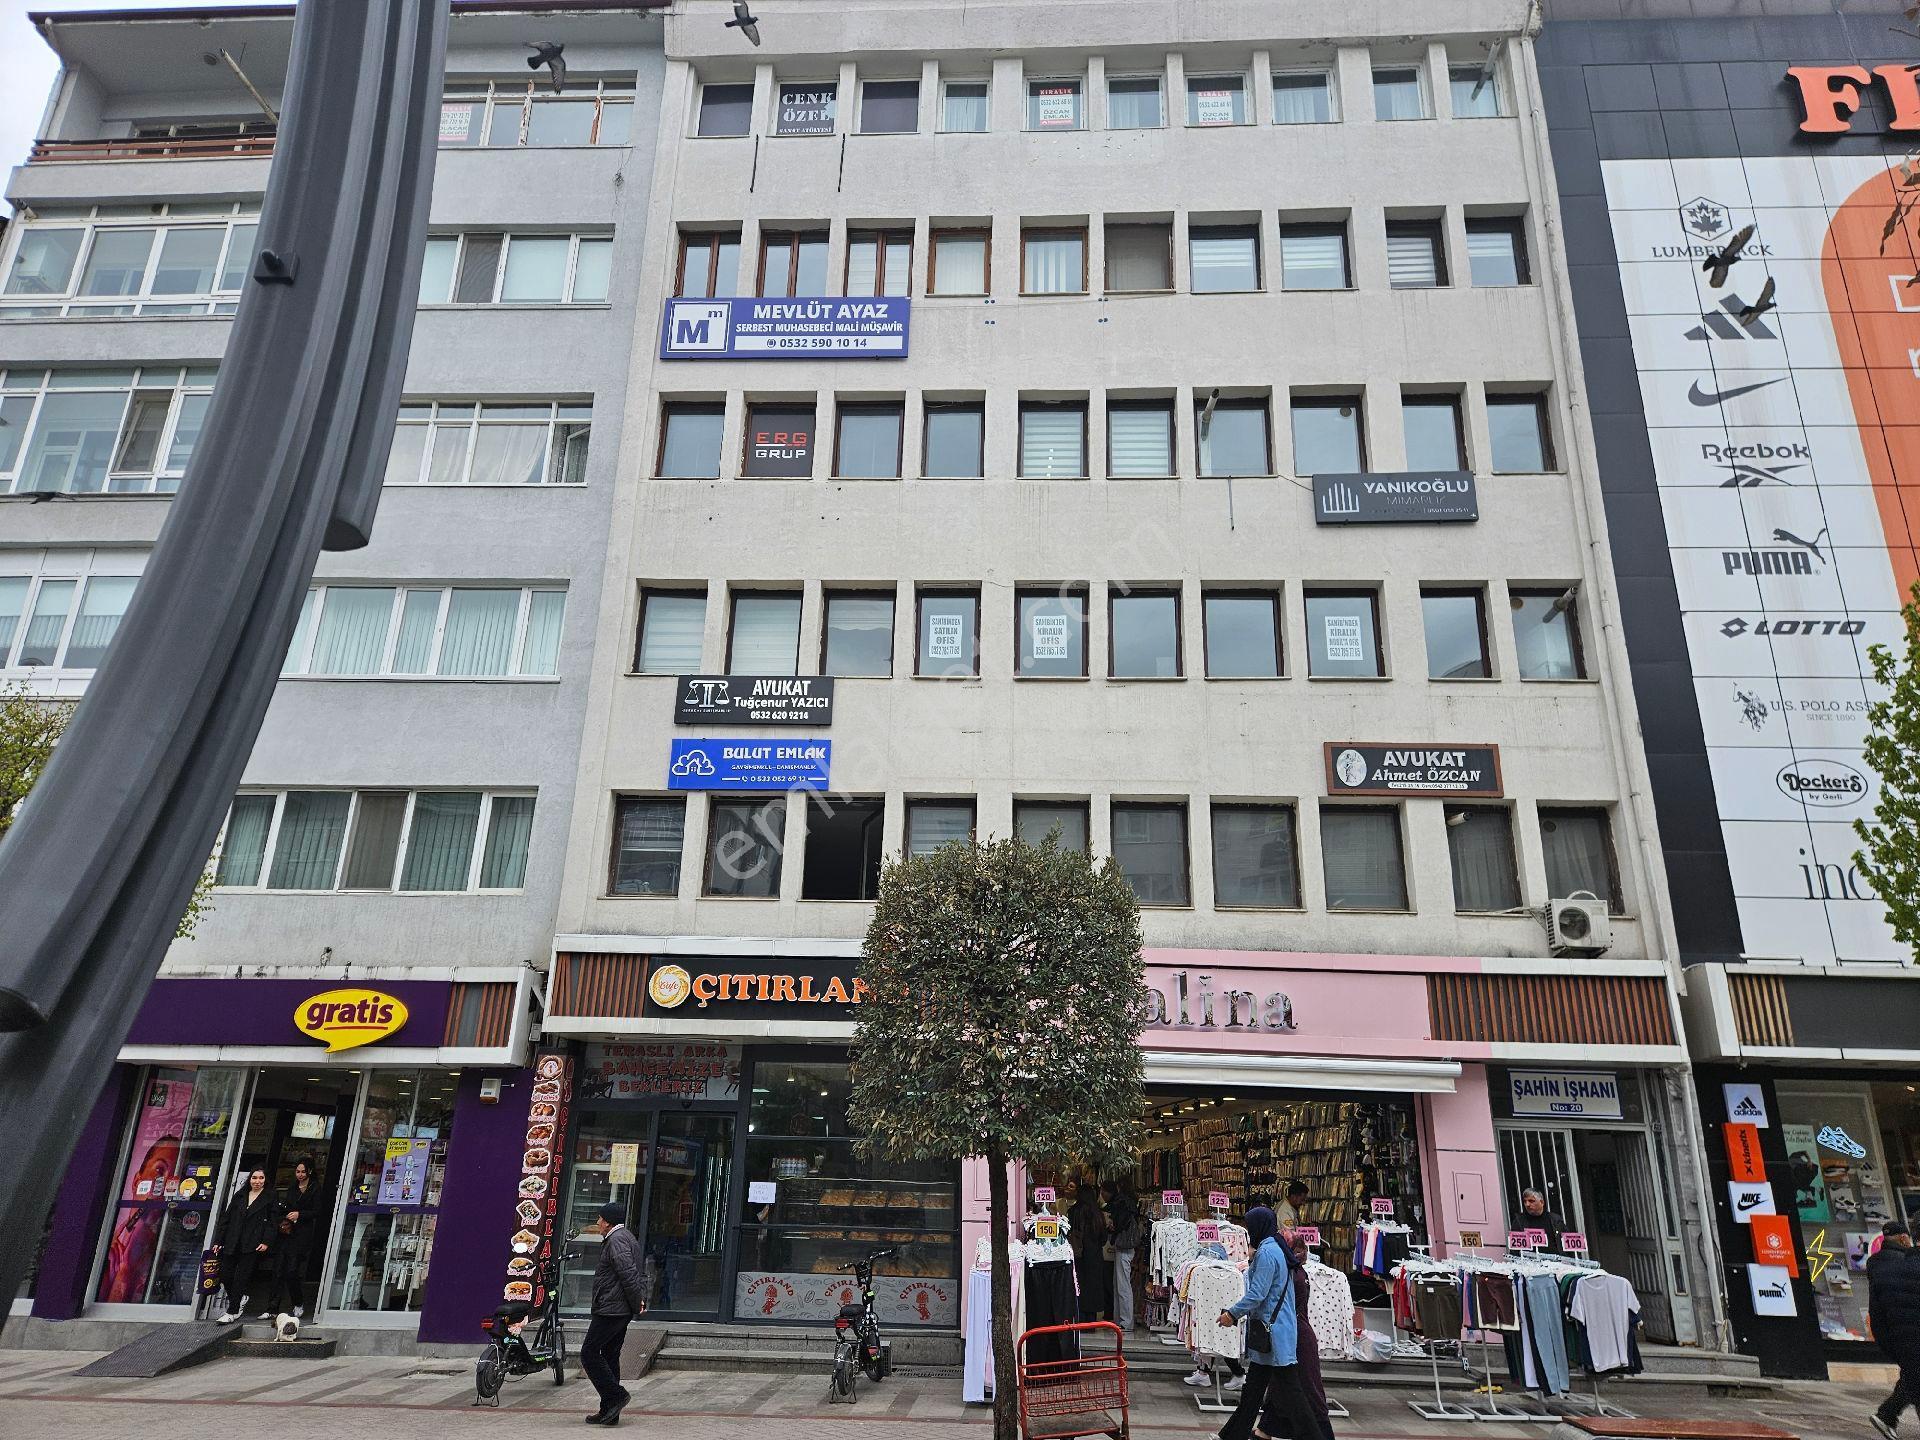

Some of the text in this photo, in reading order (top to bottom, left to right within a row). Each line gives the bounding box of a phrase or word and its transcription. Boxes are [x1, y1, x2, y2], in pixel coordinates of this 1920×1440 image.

[782, 92, 834, 105] CENK
[1652, 245, 1774, 258] LUMBERCK
[753, 301, 889, 319] MEVLÜT AYAZ
[735, 322, 904, 334] SERBEST MUHASEBECİ MALİ MÜŞAVİR
[779, 338, 868, 348] 0532 590 10 14
[756, 432, 807, 444] ERG
[755, 449, 806, 459] GRUP
[1701, 443, 1810, 462] Reebok
[1363, 478, 1469, 494] YANIKOĞLU
[1722, 551, 1813, 576] PUMA
[1754, 620, 1866, 636] LOTTO
[752, 679, 812, 696] AVUKAT
[733, 696, 829, 709] Tuğçenur YAZICI
[1770, 700, 1877, 712] U.S. POLO ASS
[750, 711, 809, 720] 0532 620 9214
[1806, 713, 1833, 721] SINCE
[722, 747, 826, 759] BULUT EMLAK
[1383, 751, 1466, 768] AVUKAT
[1371, 767, 1482, 782] Ahmet ÖZCAN
[1808, 792, 1843, 801] by Gerli
[1798, 848, 1881, 900] inc
[305, 995, 394, 1031] gratis
[603, 1045, 728, 1058] TERASLI ARKA
[1513, 1076, 1616, 1102] ŞAHİN İŞHANI
[1551, 1103, 1583, 1112] No: 20
[1734, 1108, 1763, 1116] adidas
[1739, 1128, 1752, 1166] kinetix
[1036, 1193, 1051, 1201] 120
[1740, 1193, 1762, 1203] NIKE
[1374, 1204, 1389, 1212] 250
[1200, 1231, 1214, 1239] 200
[1530, 1234, 1543, 1244] 00
[1462, 1238, 1478, 1246] 150
[1511, 1238, 1527, 1248] 250
[1565, 1239, 1581, 1249] 100
[747, 1276, 794, 1297] ÇITIRLAND
[899, 1282, 948, 1302] ÇITIRLAND
[1758, 1290, 1783, 1298] PUMA
